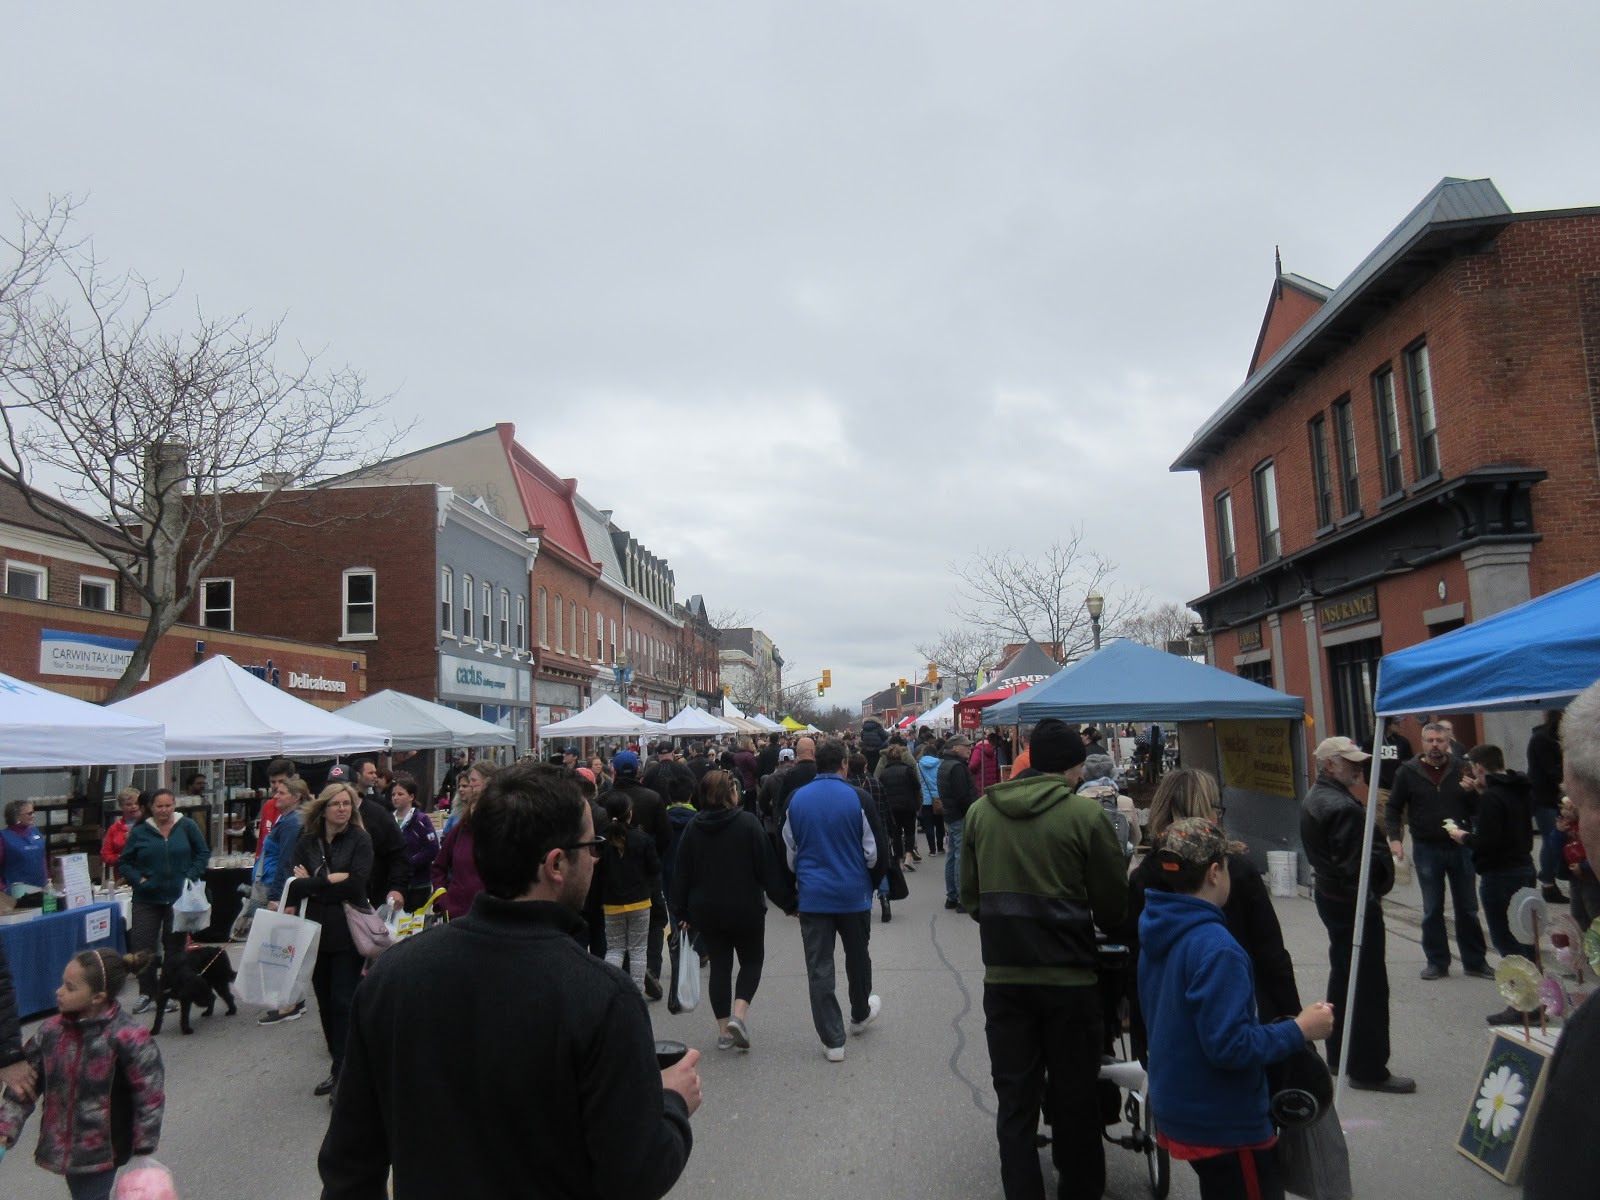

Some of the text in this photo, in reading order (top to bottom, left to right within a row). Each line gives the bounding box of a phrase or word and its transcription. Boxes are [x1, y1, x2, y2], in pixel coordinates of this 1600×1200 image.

[1321, 594, 1373, 624] INSURANCE
[53, 648, 131, 665] CARWIN TAX LIMIT
[53, 660, 64, 669] Your
[66, 661, 74, 669] Tax
[75, 662, 84, 670] and
[86, 664, 105, 672] Business
[288, 671, 346, 692] Delicatessen
[456, 665, 483, 686] cactus
